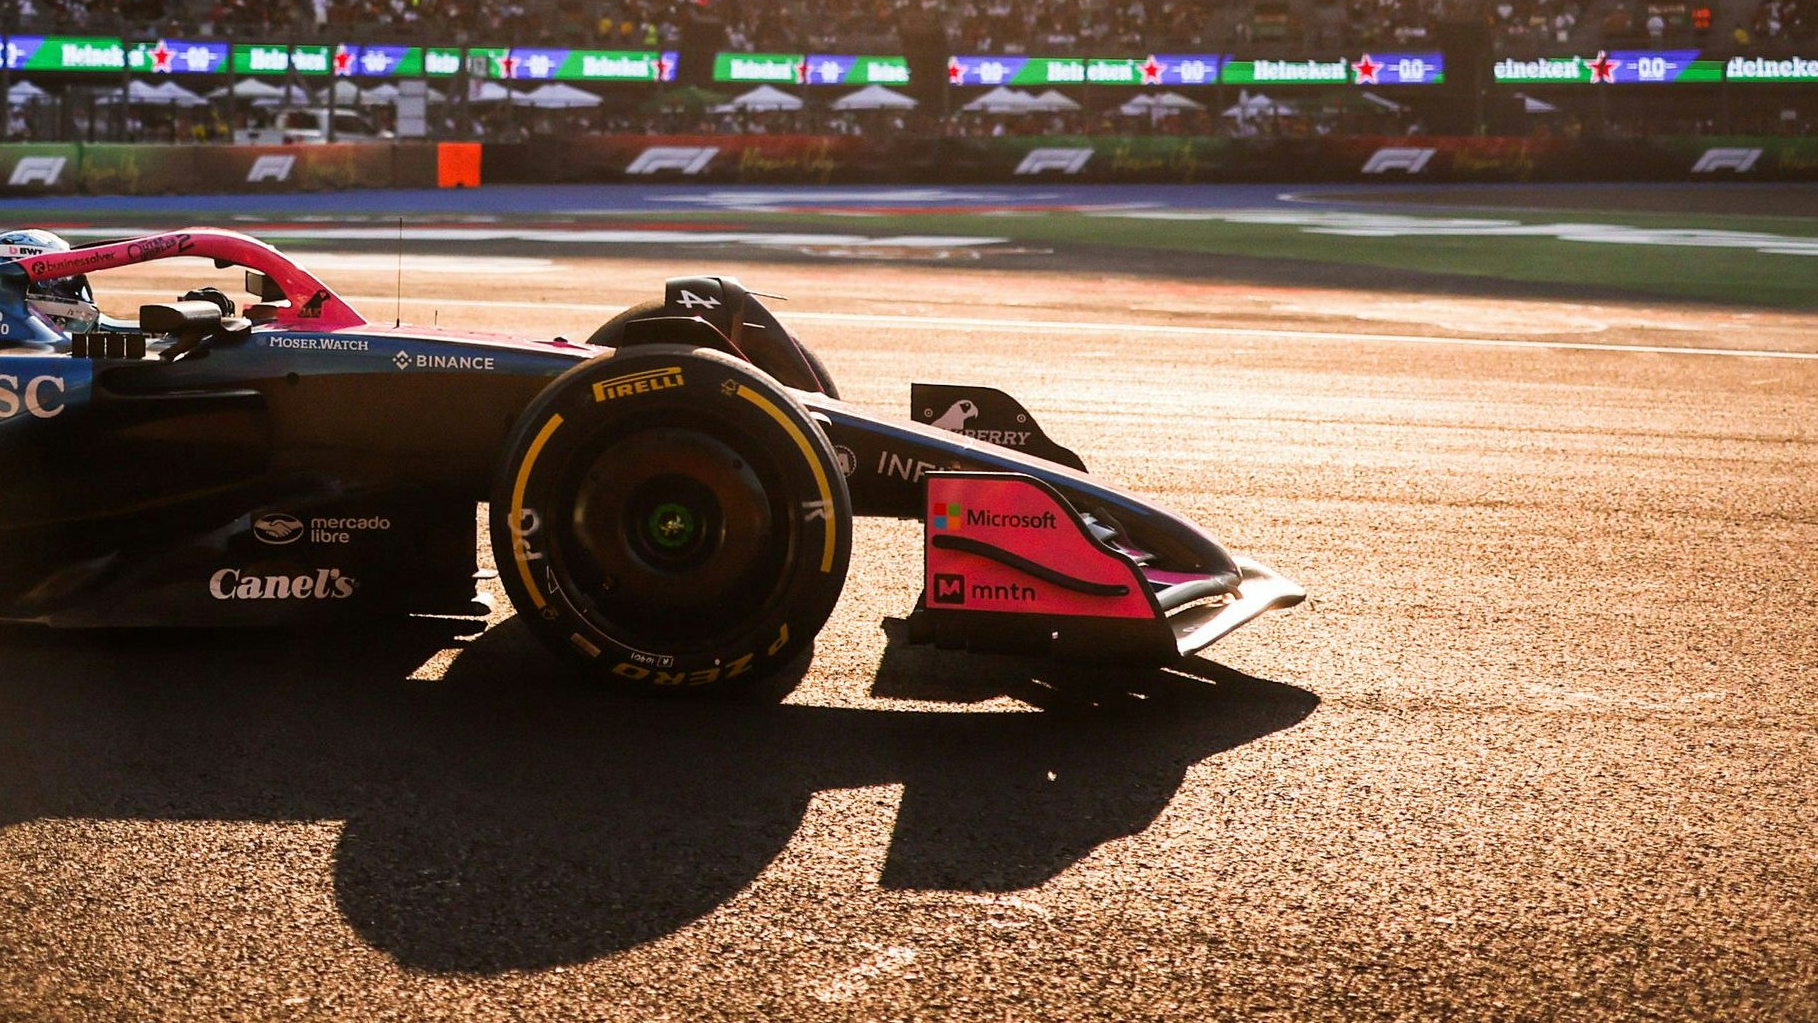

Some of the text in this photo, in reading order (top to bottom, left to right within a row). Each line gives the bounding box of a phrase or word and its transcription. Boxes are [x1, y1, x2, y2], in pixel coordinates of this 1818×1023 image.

[415, 354, 495, 370] BINANCE
[592, 366, 685, 402] PIRELLI
[311, 515, 391, 530] mercado
[966, 508, 1057, 530] Microsoft
[311, 529, 350, 544] libre
[209, 568, 356, 600] Canel's
[971, 582, 1036, 602] mntn
[612, 652, 755, 686] ZERO
